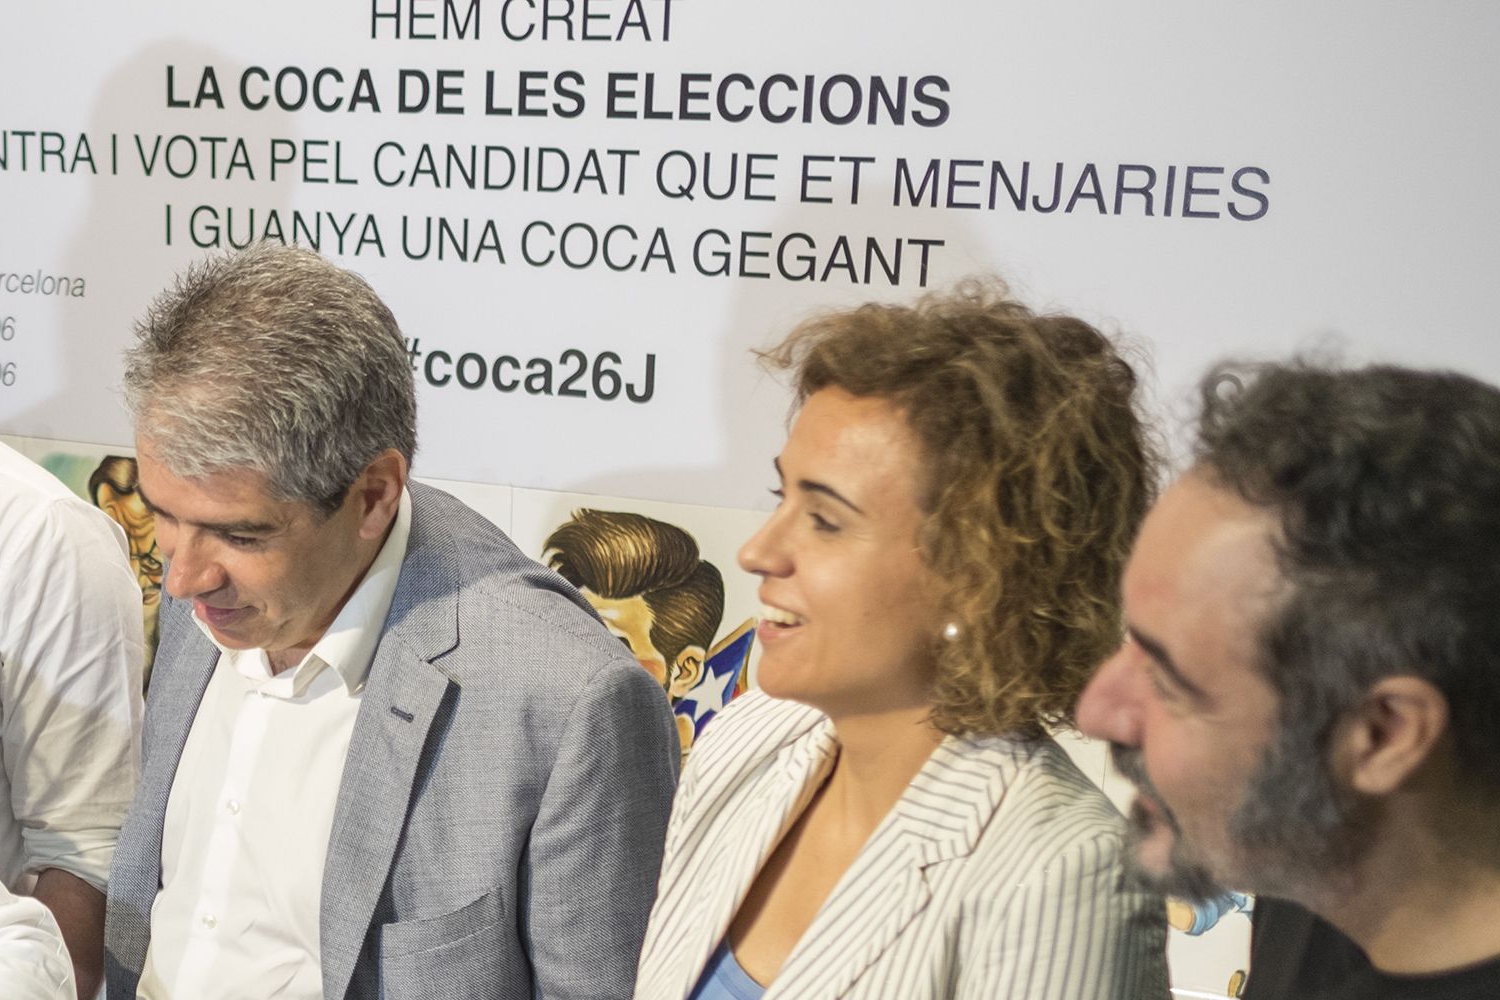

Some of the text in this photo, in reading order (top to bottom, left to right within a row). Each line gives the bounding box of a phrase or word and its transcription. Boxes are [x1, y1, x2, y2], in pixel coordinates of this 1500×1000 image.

[371, 0, 481, 41] HEM
[166, 65, 950, 128] LA COCA DE LES ELECCIONS
[110, 133, 118, 176] I
[134, 134, 255, 181] VOTA
[270, 138, 358, 185] PEL
[373, 141, 640, 196] CANDIDAT
[656, 150, 779, 203] QUE
[800, 154, 876, 205] ET
[892, 157, 1270, 222] MENJARIES
[165, 204, 946, 288] I GUANYA UNA COCA GEGANT
